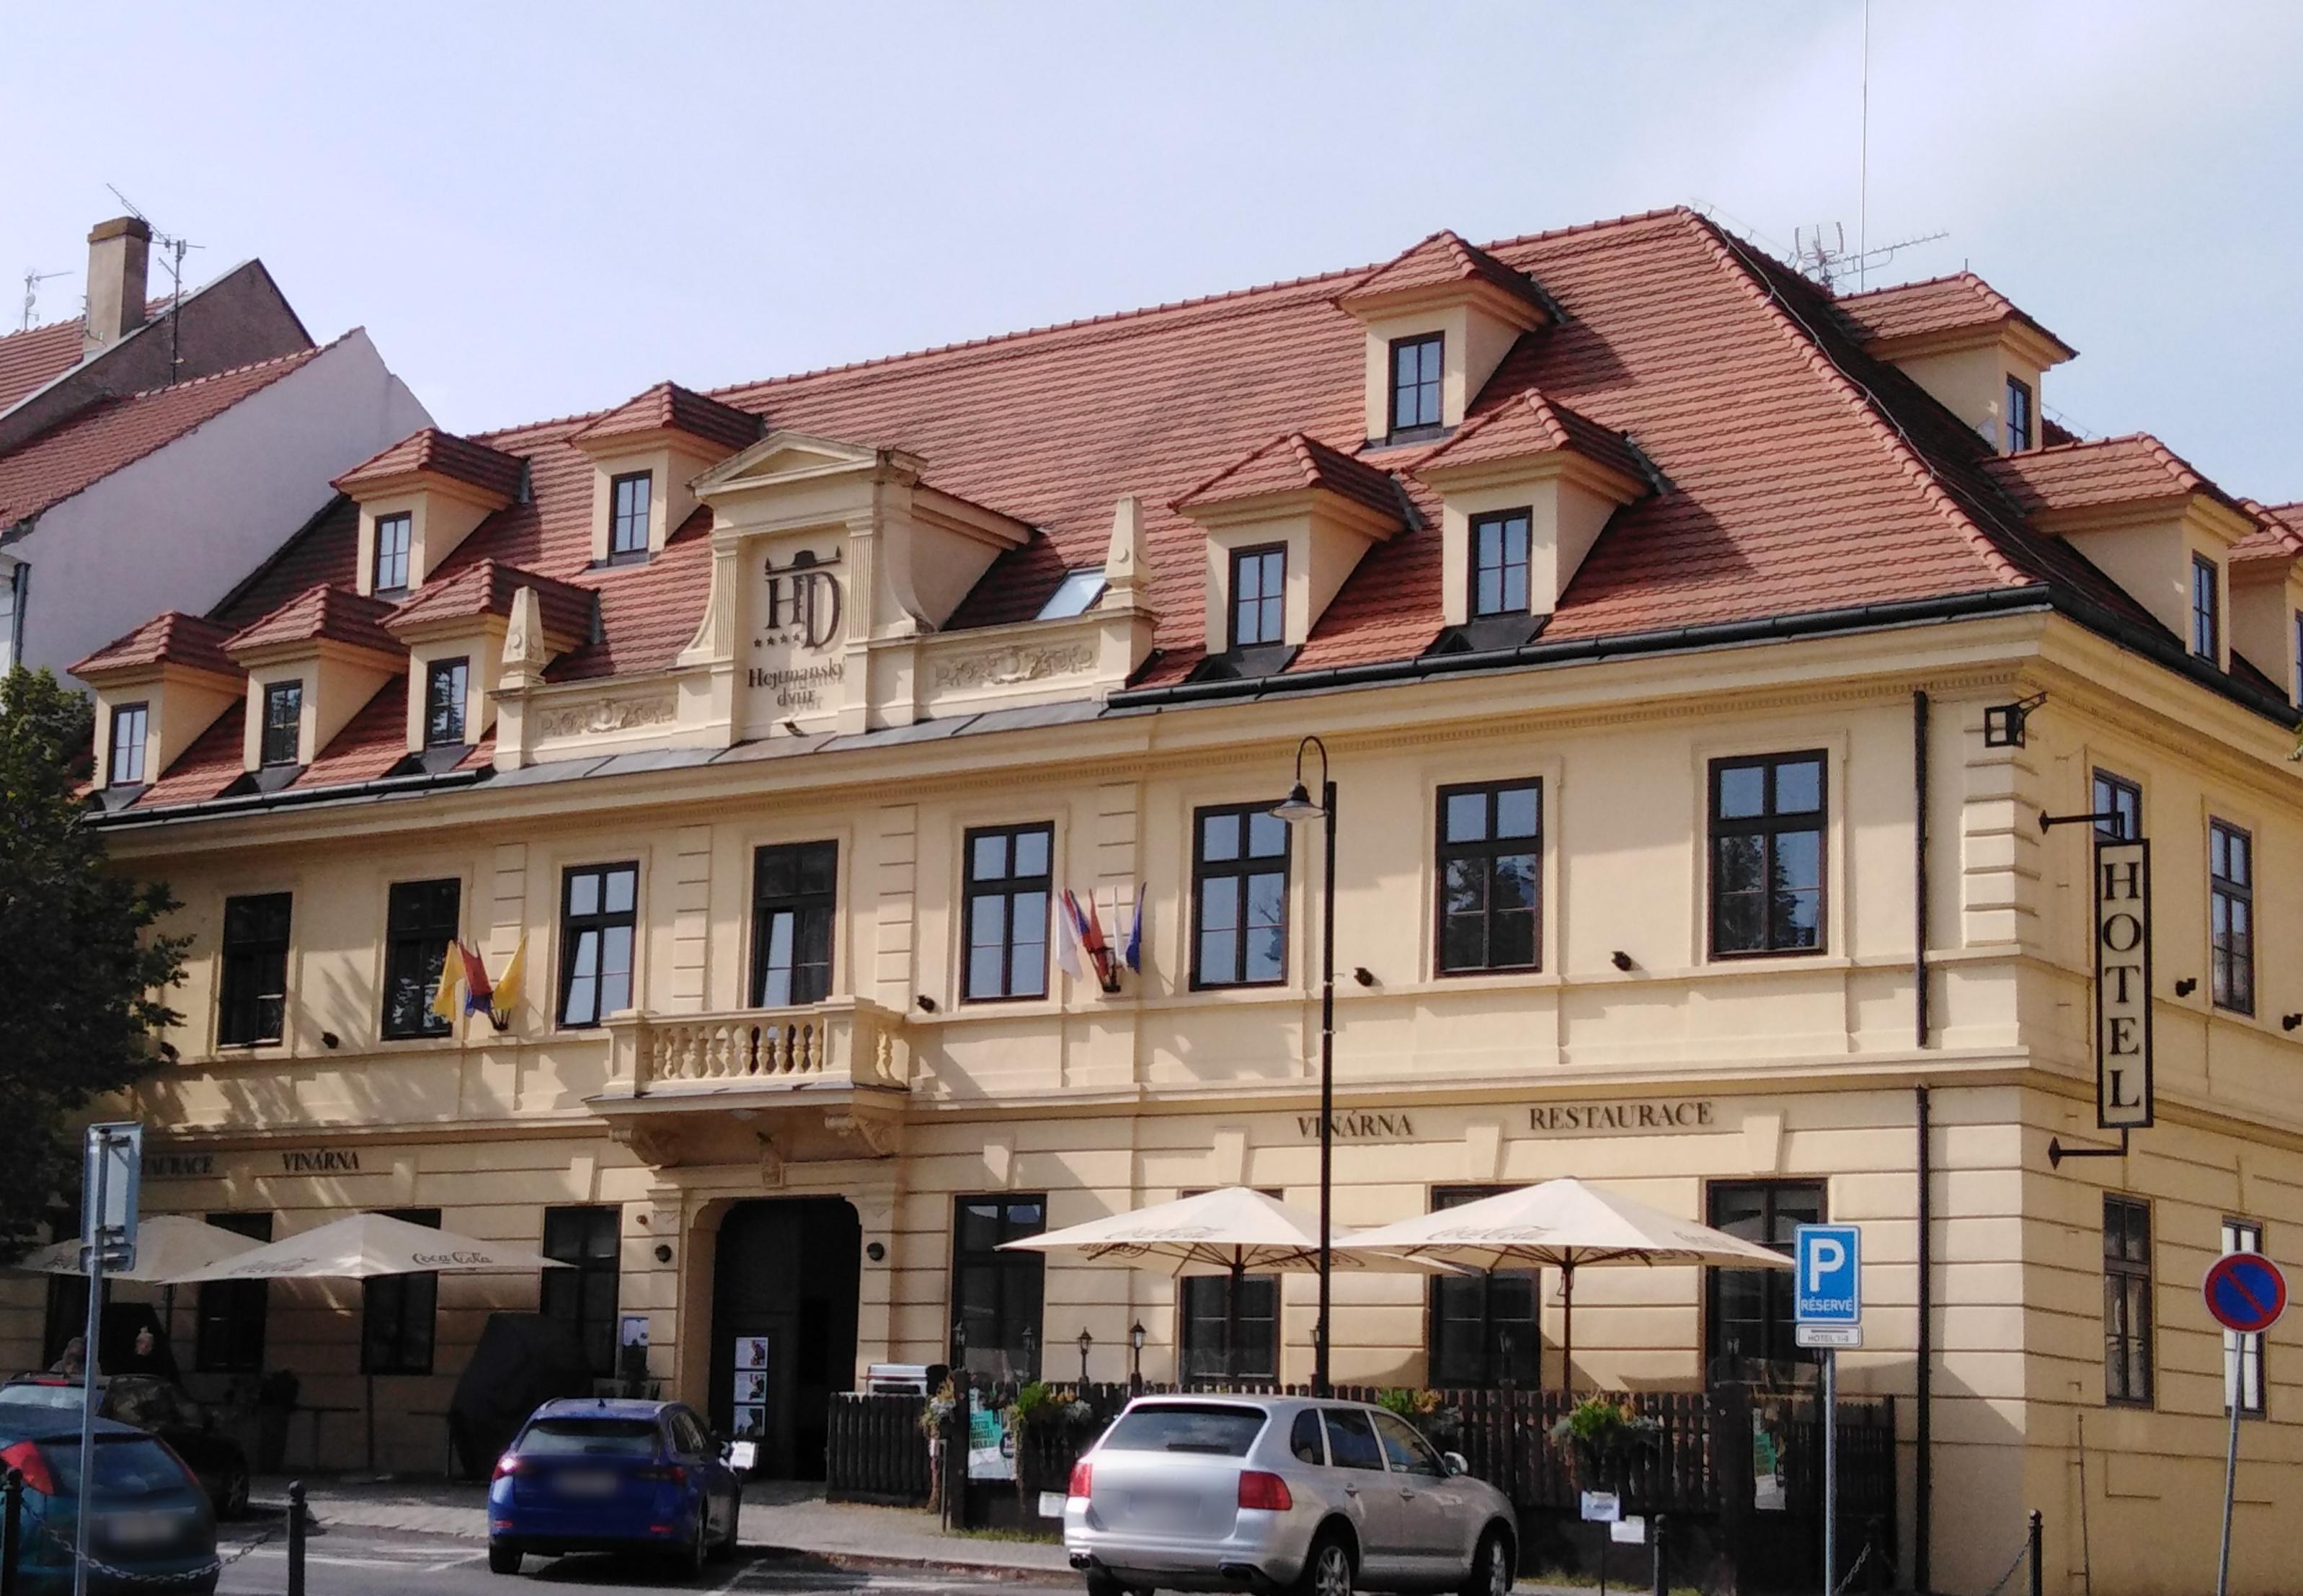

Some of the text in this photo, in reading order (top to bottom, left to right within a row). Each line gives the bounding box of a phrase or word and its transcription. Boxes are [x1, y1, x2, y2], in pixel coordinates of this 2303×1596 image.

[2103, 861, 2142, 1109] HOTEL
[1297, 1109, 1414, 1138] VINÁRNA
[1529, 1101, 1714, 1130] RESTAURACE
[282, 1146, 360, 1172] VINÁRNA
[1809, 1238, 1845, 1293] P
[1801, 1295, 1854, 1313] RÉSERVÉ
